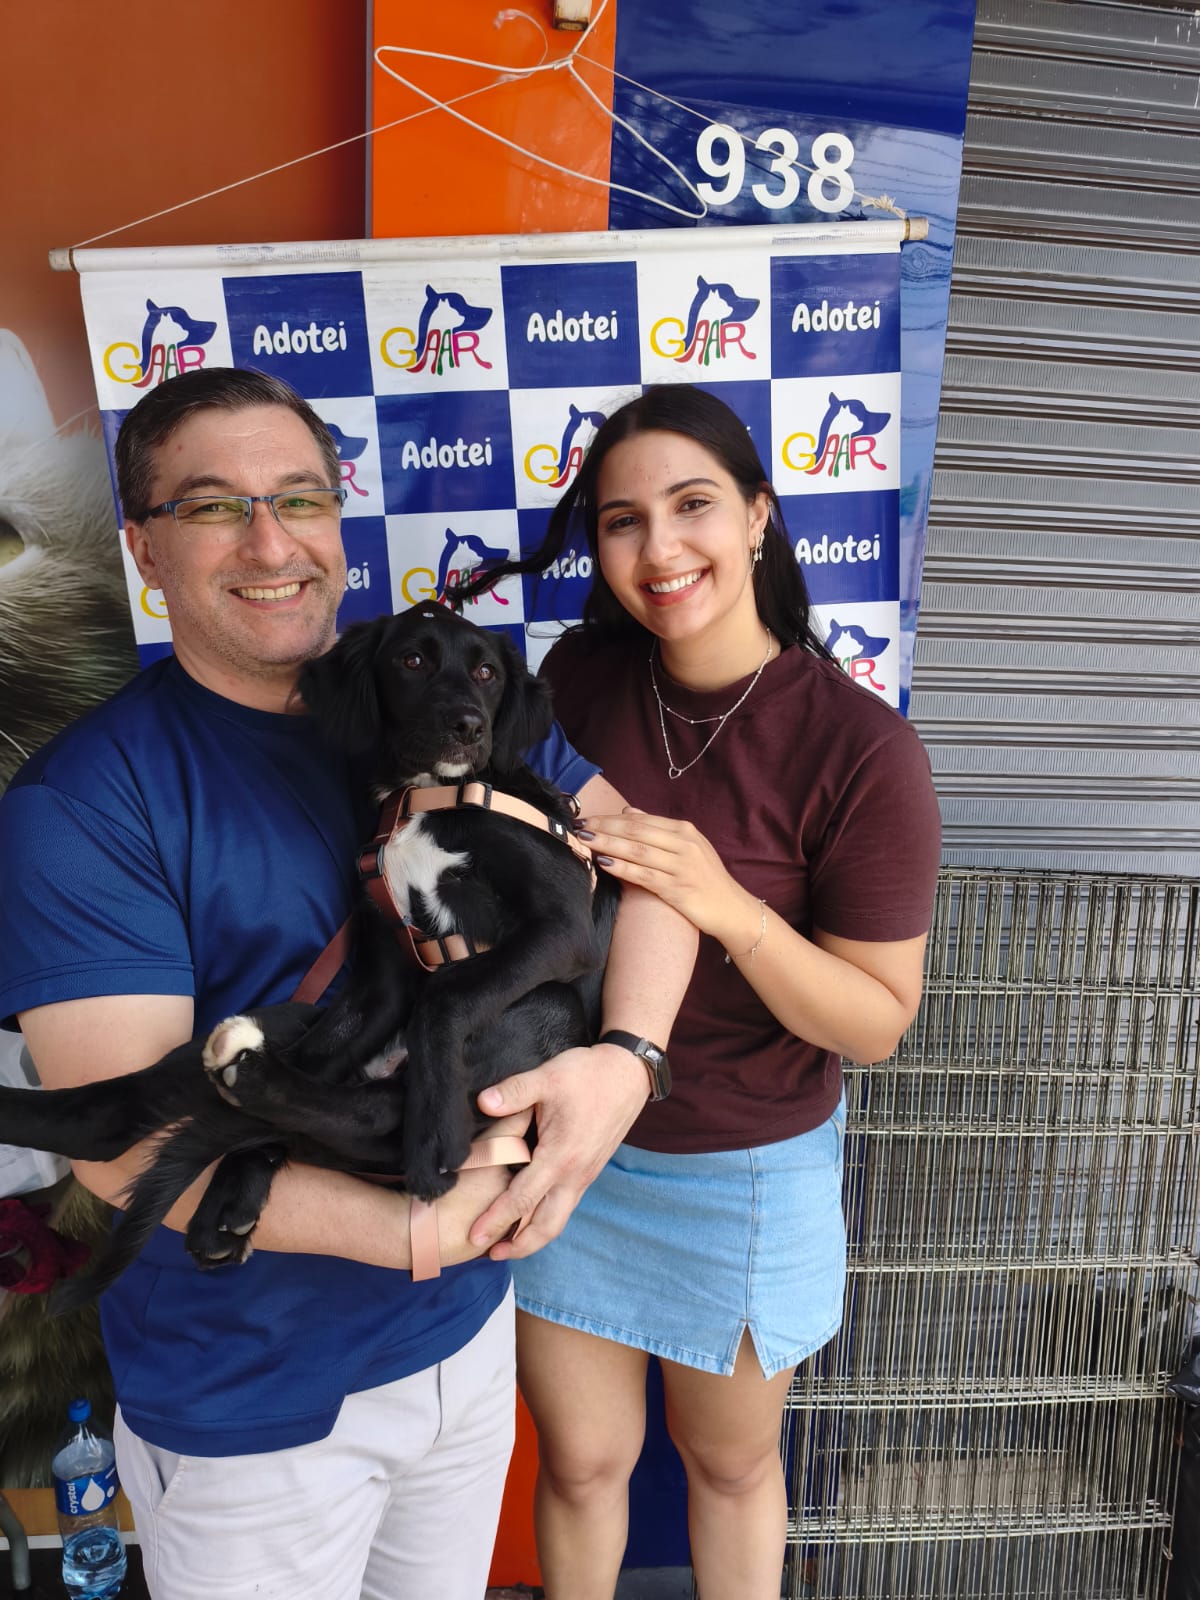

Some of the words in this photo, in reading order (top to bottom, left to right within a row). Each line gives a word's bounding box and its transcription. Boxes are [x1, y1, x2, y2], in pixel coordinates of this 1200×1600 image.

[696, 123, 855, 213] 938
[527, 309, 618, 343] Adotei
[792, 300, 881, 334] Adotei
[253, 320, 347, 355] Adotei
[380, 327, 493, 376] GAAR
[649, 316, 757, 366] GAAR
[103, 341, 206, 389] GAAR
[401, 437, 493, 470] Adotei
[523, 443, 584, 488] GA
[781, 431, 887, 478] GAAR
[541, 548, 594, 580] Ado
[794, 533, 880, 566] Adotei
[66, 1482, 79, 1514] crystal
